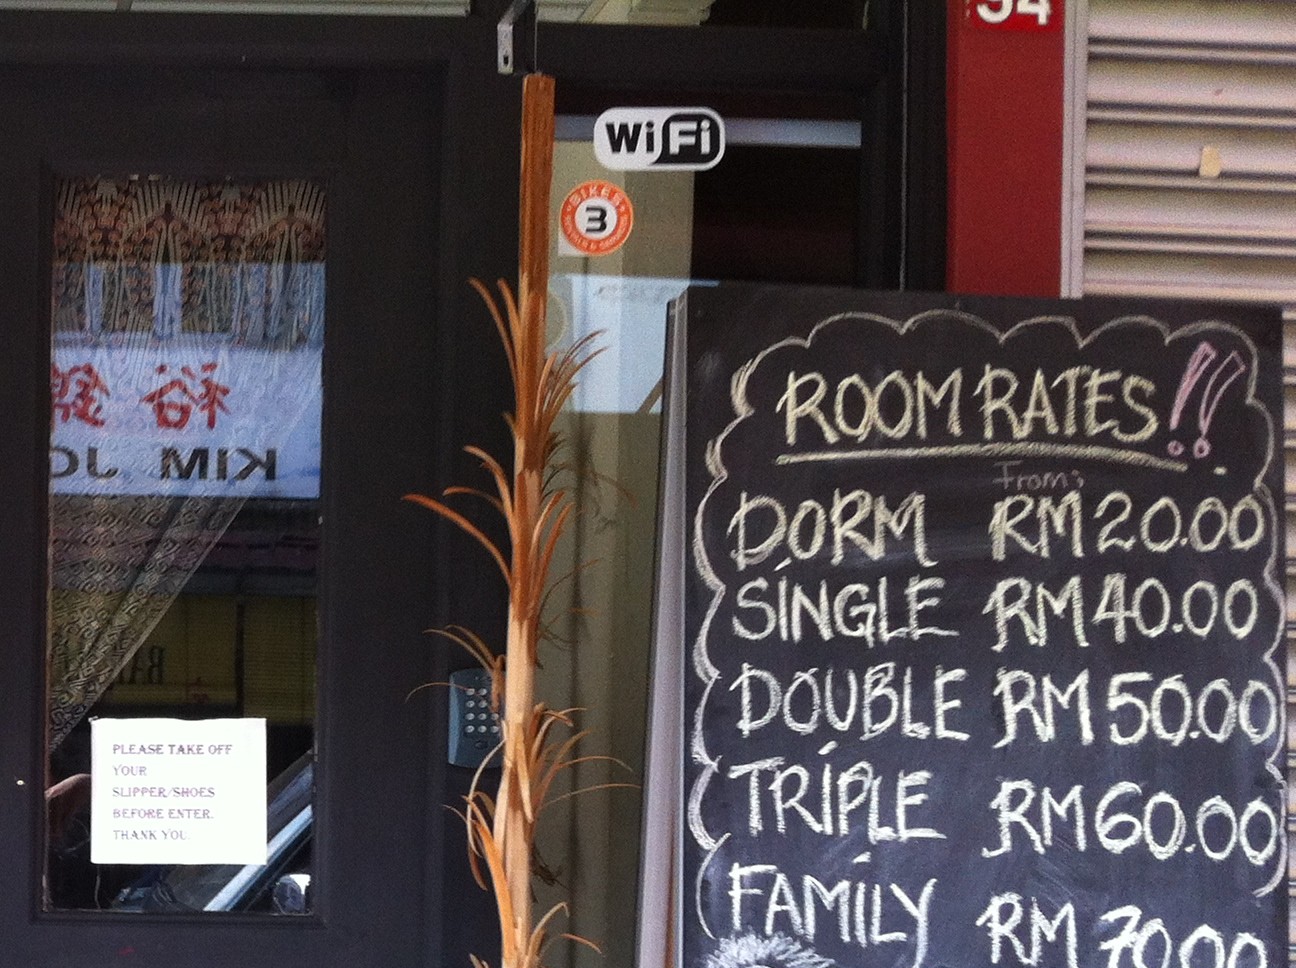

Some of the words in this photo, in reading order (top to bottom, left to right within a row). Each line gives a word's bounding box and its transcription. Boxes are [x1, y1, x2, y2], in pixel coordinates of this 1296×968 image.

[585, 206, 609, 235] 3
[777, 367, 964, 445] ROOM
[728, 489, 938, 571] DORM
[731, 661, 970, 741] DOUBLE
[112, 744, 164, 755] PLEASE
[168, 744, 205, 755] TAKE
[208, 744, 233, 755] OFF
[112, 765, 147, 776] YOUR
[112, 787, 216, 798] SLIPPER/SHOES
[112, 808, 164, 819] BEFORE
[168, 808, 214, 819] ENTER.
[113, 829, 157, 840] THANK
